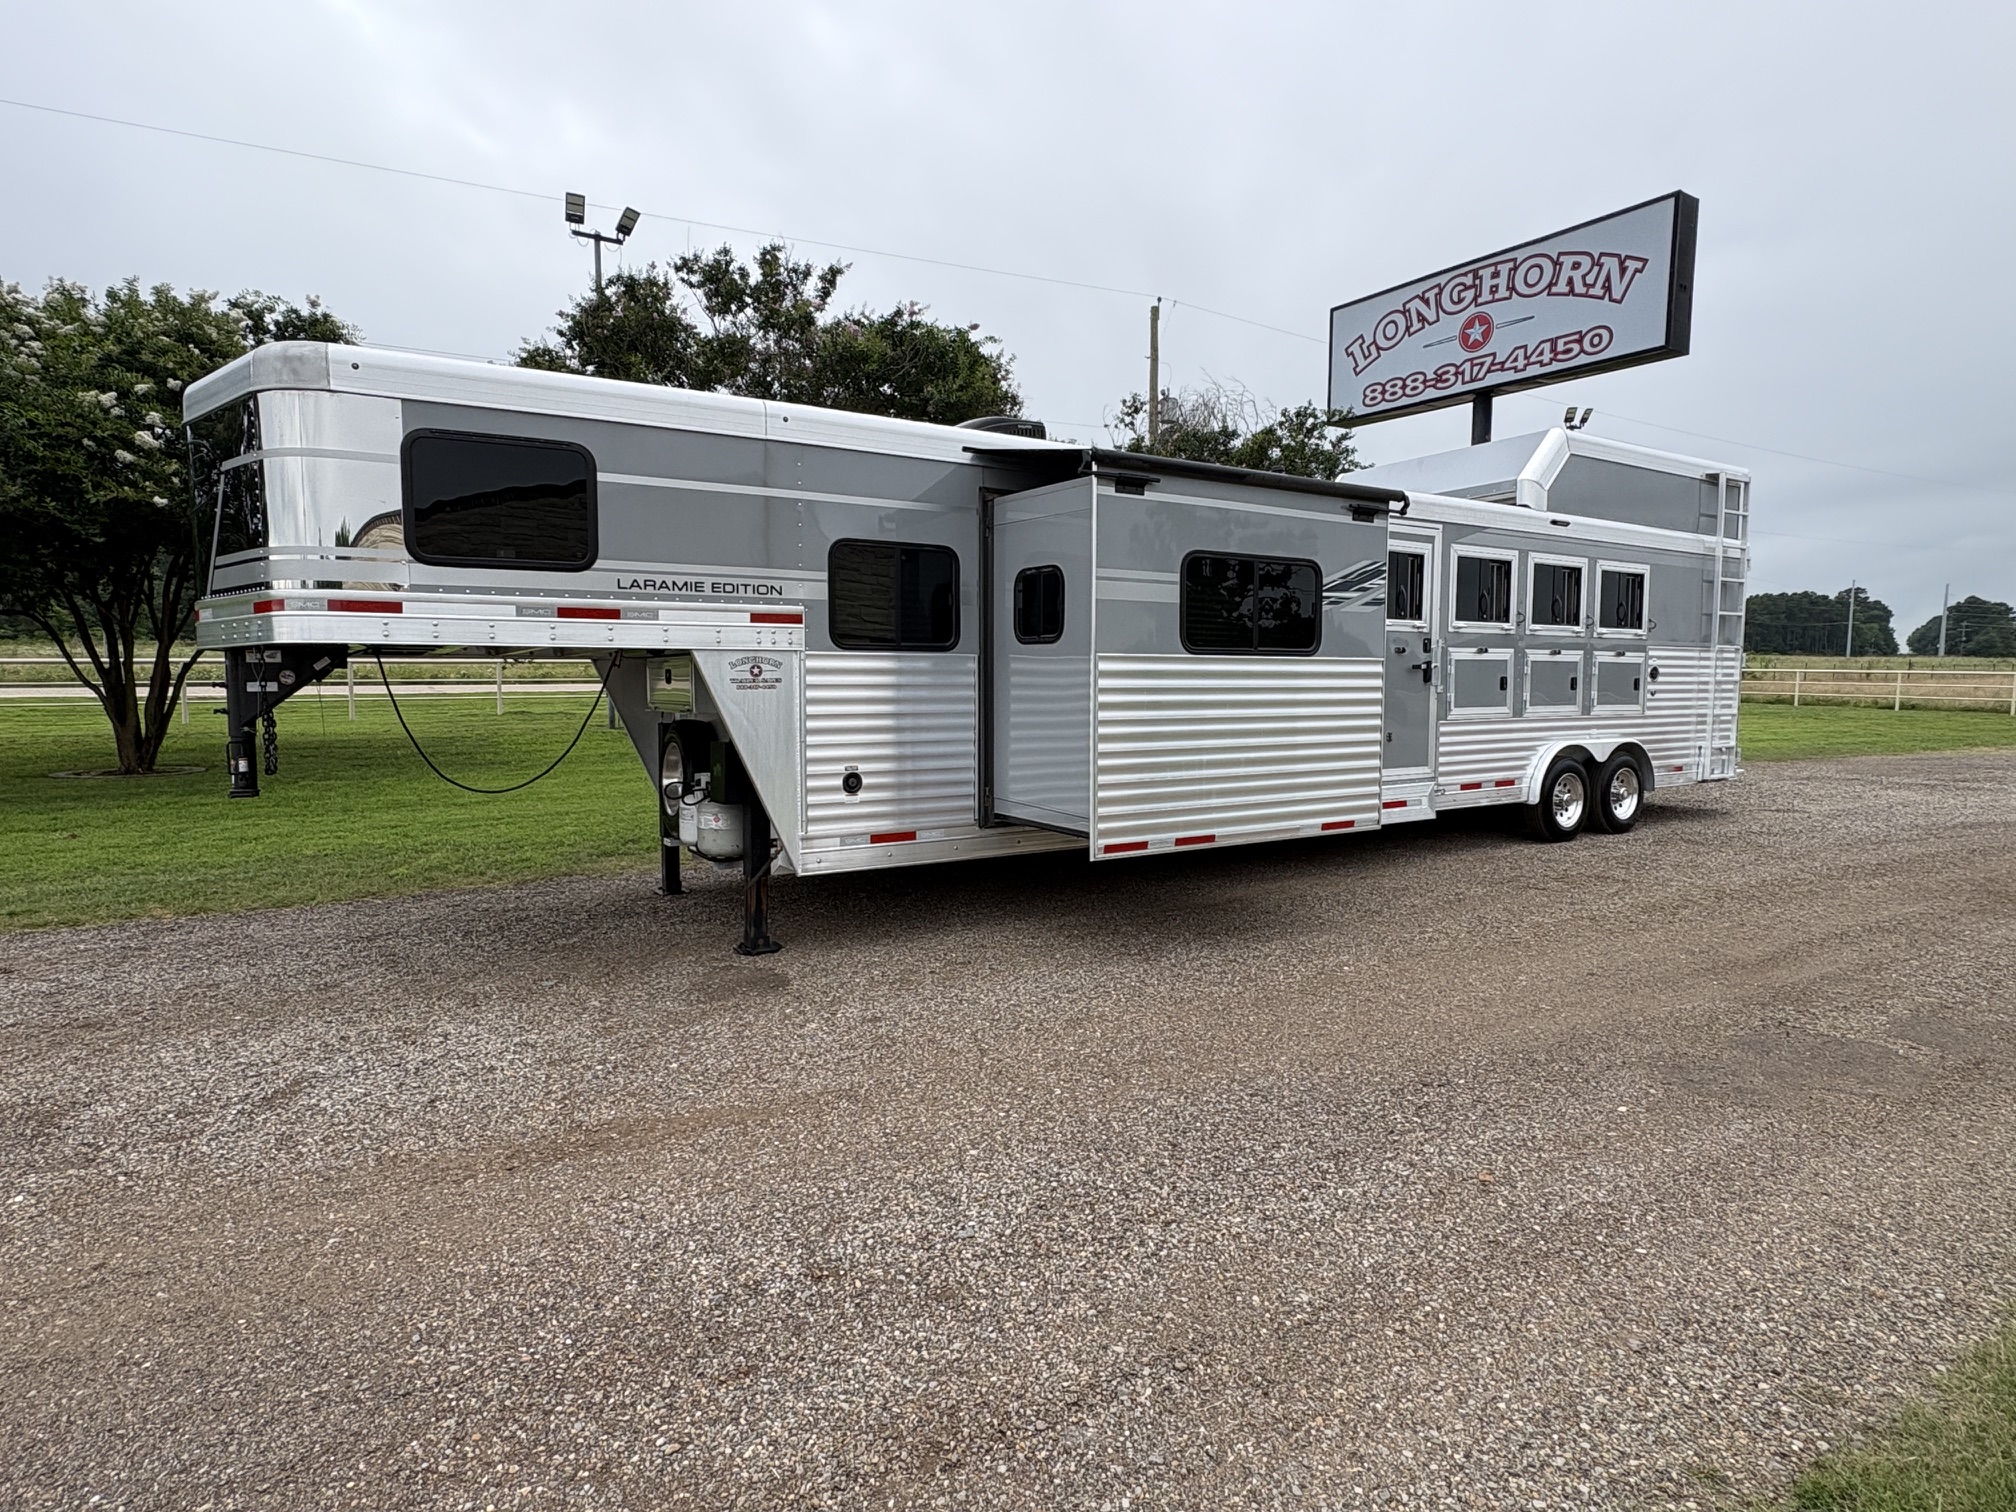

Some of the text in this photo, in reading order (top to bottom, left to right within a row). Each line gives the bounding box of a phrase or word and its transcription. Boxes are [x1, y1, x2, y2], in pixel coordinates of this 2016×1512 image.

[1345, 251, 1649, 376] LONGHORN
[1362, 325, 1614, 407] 888-317-4450
[617, 578, 783, 596] LARAMIE EDITION
